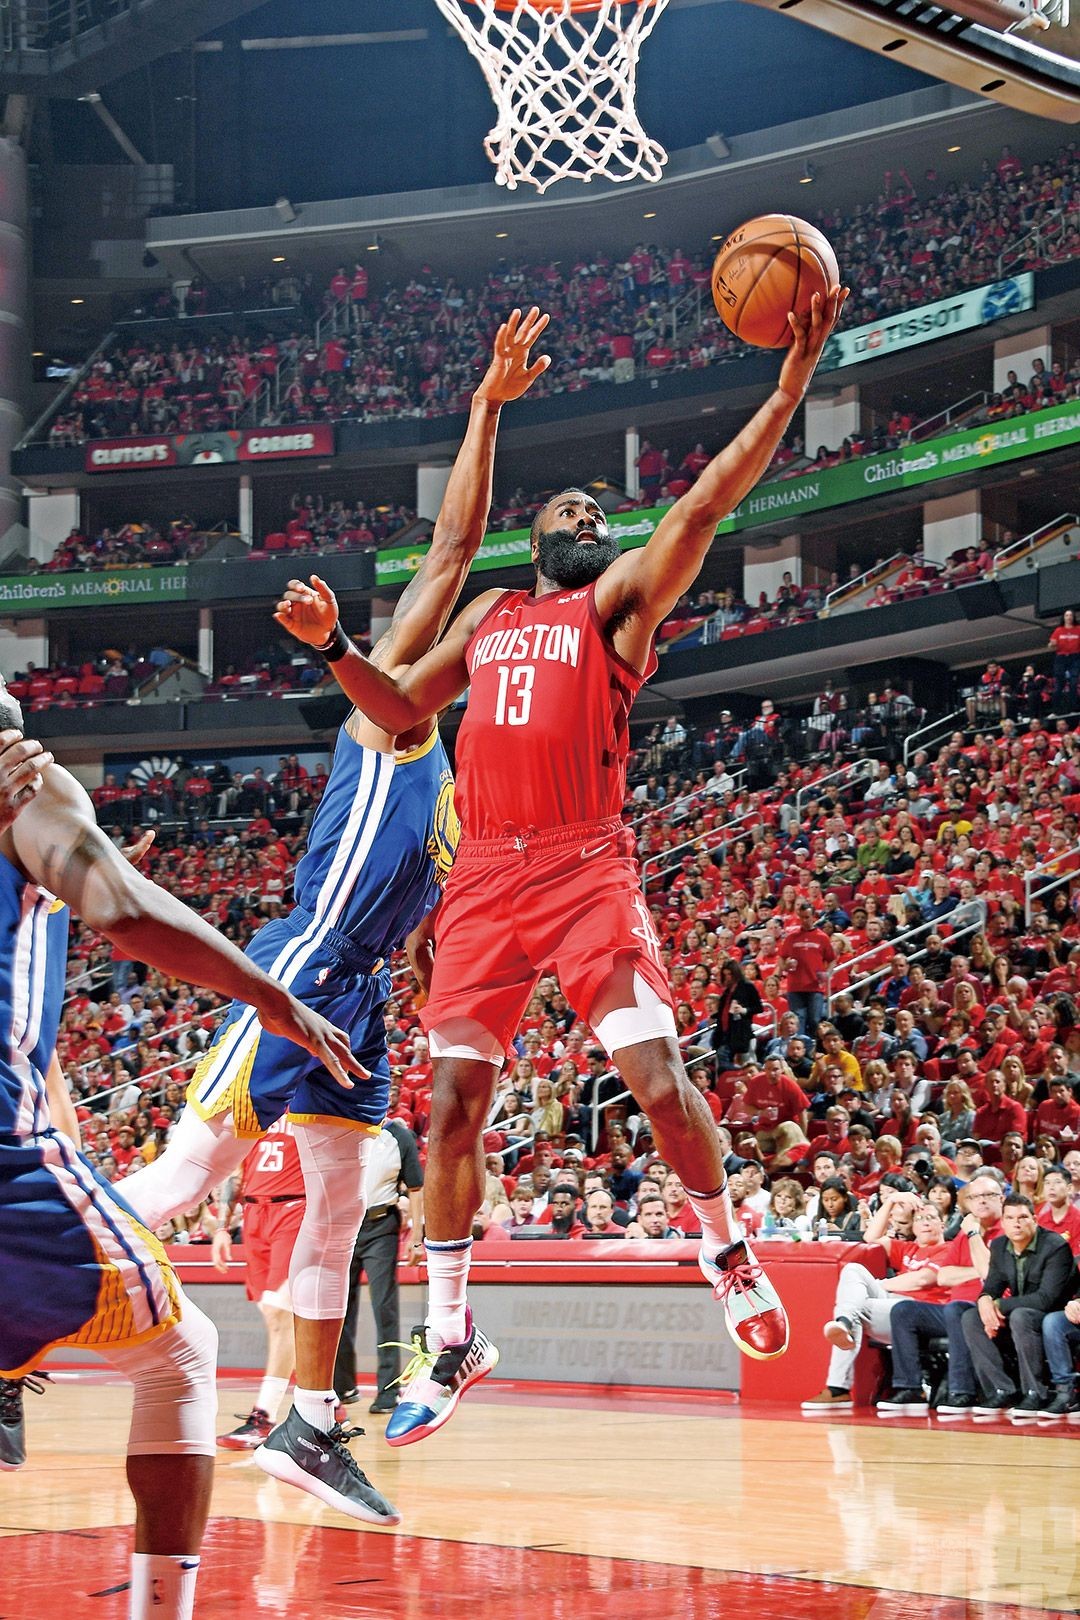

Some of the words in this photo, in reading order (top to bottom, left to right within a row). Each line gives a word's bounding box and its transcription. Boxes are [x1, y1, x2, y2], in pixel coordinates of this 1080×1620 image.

[885, 303, 965, 343] TISSOT
[247, 433, 315, 454] CORNER
[863, 451, 938, 484] Children's
[941, 426, 1029, 464] MEMORIAL
[749, 483, 820, 514] HERMANN
[71, 577, 154, 597] MEMORIAL
[471, 623, 580, 676] HOUSTON
[494, 664, 536, 726] 13
[256, 1140, 285, 1172] 25
[623, 1301, 706, 1331] ACCESS
[612, 1340, 666, 1370] FREE
[669, 1342, 729, 1373] TRIAL
